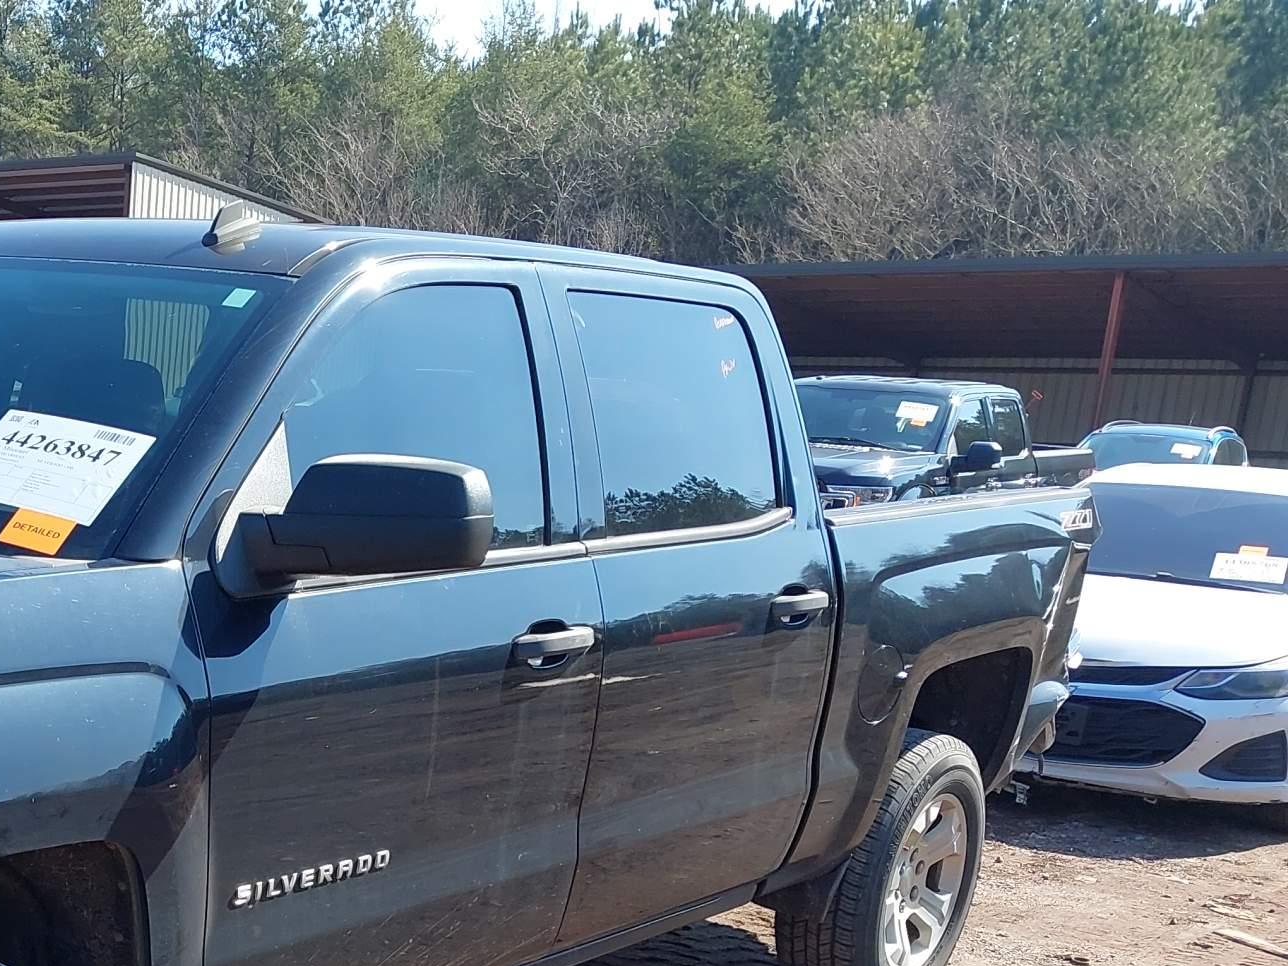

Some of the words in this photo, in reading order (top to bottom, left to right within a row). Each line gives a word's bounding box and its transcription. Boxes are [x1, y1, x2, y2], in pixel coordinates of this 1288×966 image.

[1, 430, 123, 466] 44263847
[12, 521, 61, 540] DETAILED
[231, 848, 391, 908] SILVERADO
